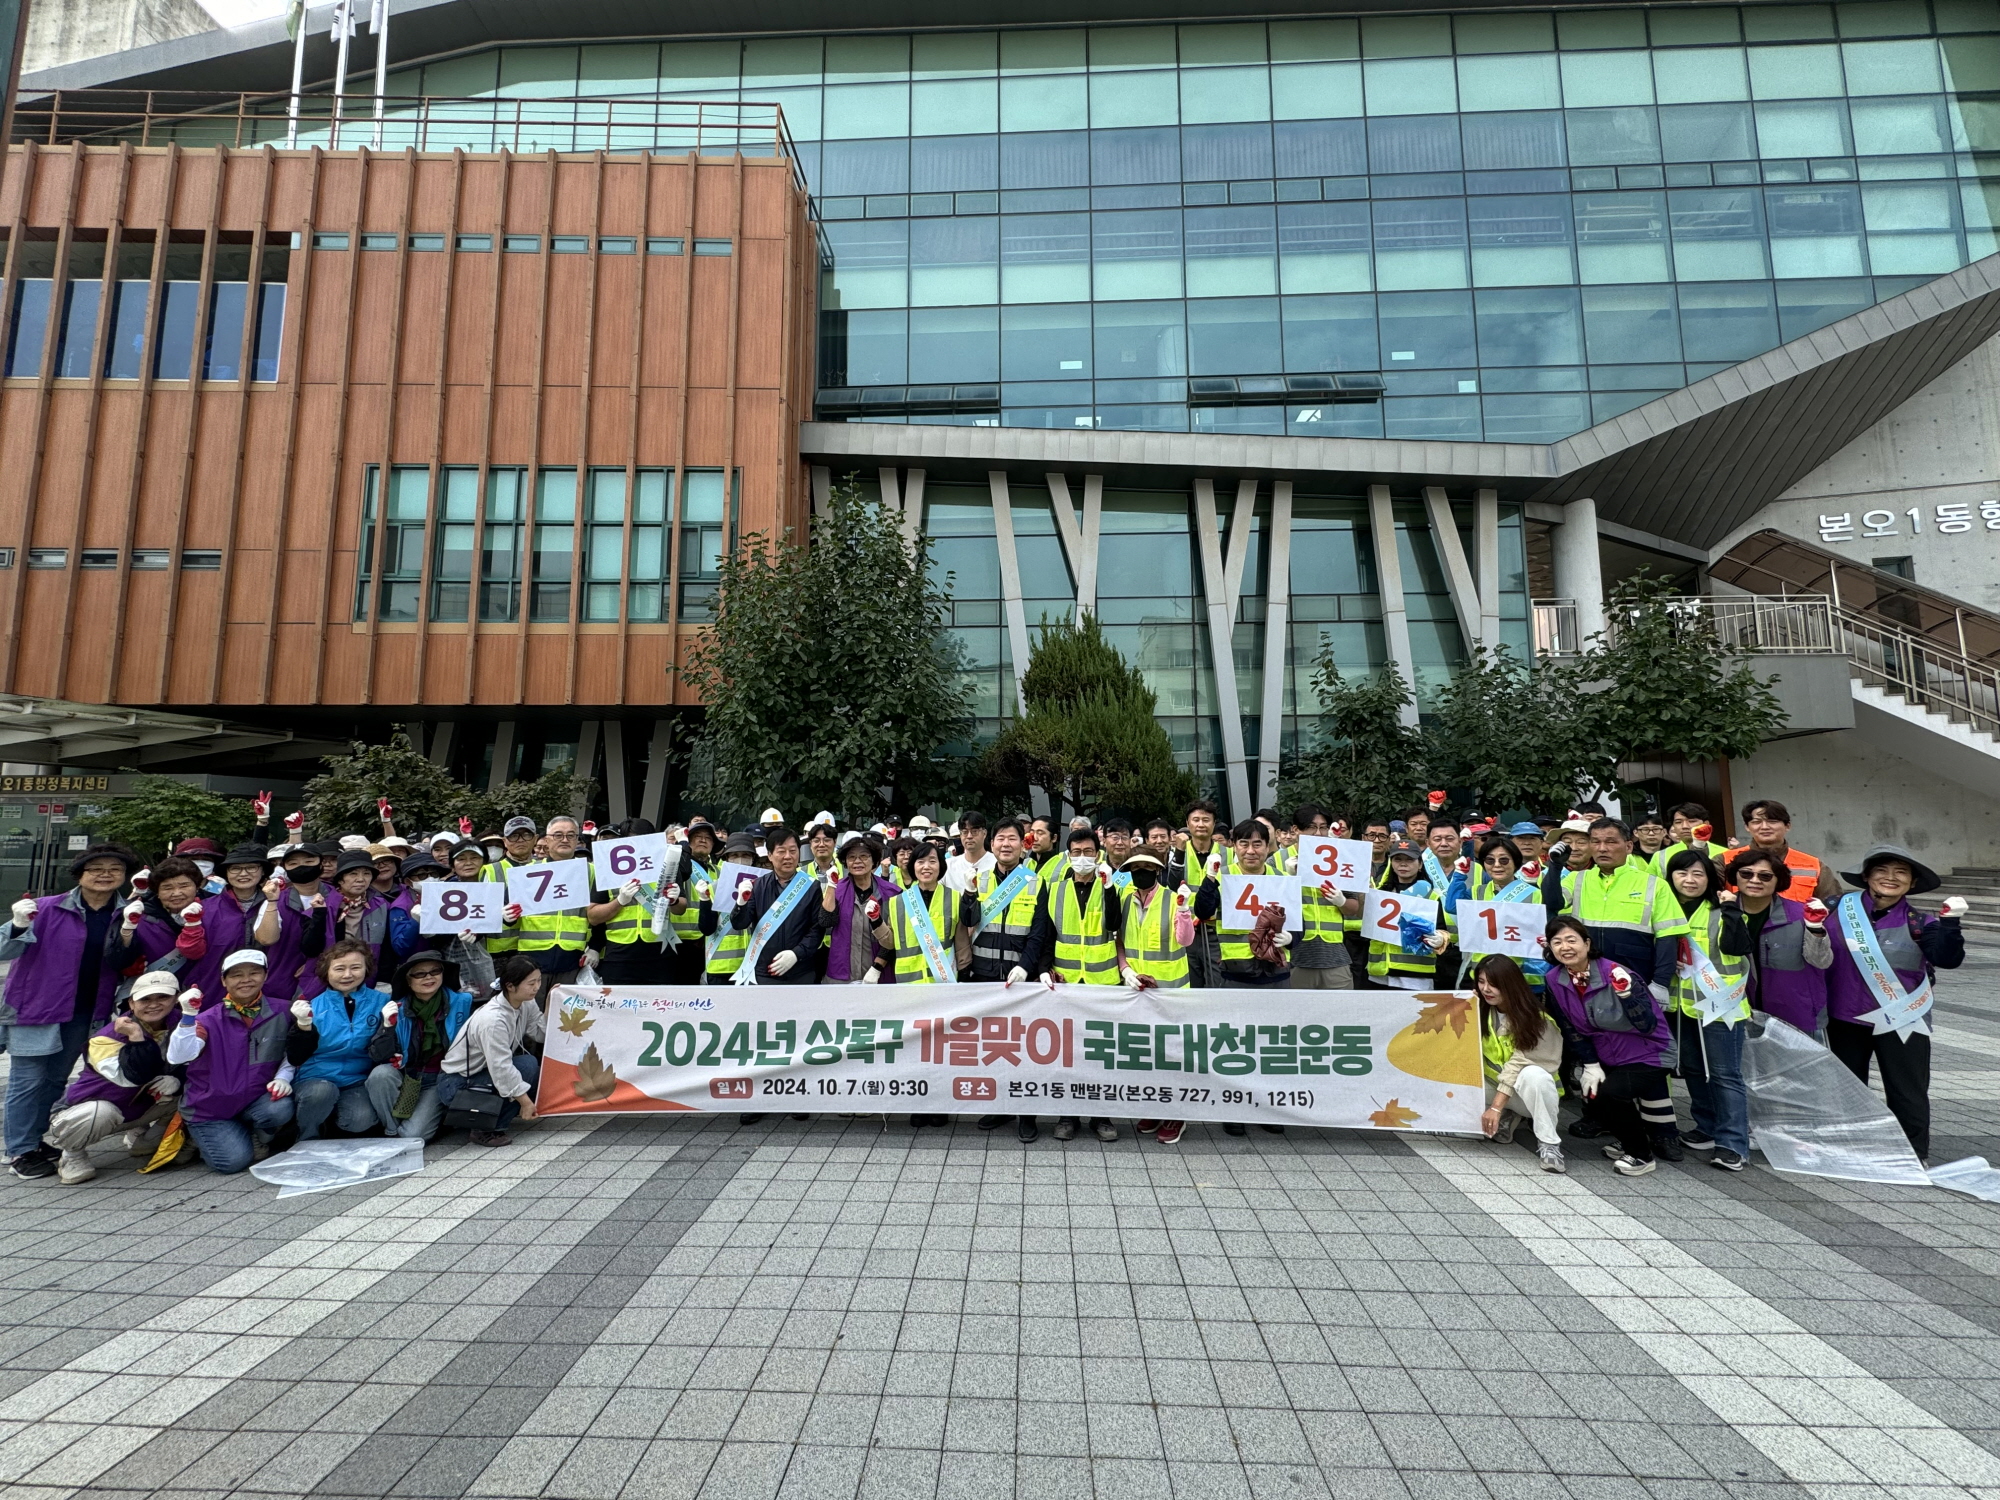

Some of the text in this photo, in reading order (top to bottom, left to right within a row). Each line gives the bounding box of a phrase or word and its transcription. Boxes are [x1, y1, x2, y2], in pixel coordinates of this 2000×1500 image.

[0, 776, 108, 792] 오1동행정복지센터
[610, 845, 654, 876] 6조
[1313, 845, 1354, 878] 3조
[526, 870, 569, 902] 7조
[1235, 883, 1279, 916] 4
[439, 890, 486, 921] 8조
[1479, 908, 1521, 941] 1조
[1851, 921, 1861, 929] 내
[1864, 956, 1880, 970] 내가
[688, 998, 715, 1011] 안산
[637, 1017, 1373, 1076] 2024년 상록구 가을맞이 국토대청결운동
[763, 1079, 810, 1095] 2024.
[818, 1079, 841, 1095] 10.
[889, 1080, 928, 1096] 9:30
[1008, 1081, 1065, 1098] 본오1동
[1178, 1088, 1216, 1105] 727,
[1222, 1090, 1259, 1108] 991,
[1267, 1090, 1315, 1109] 1215)
